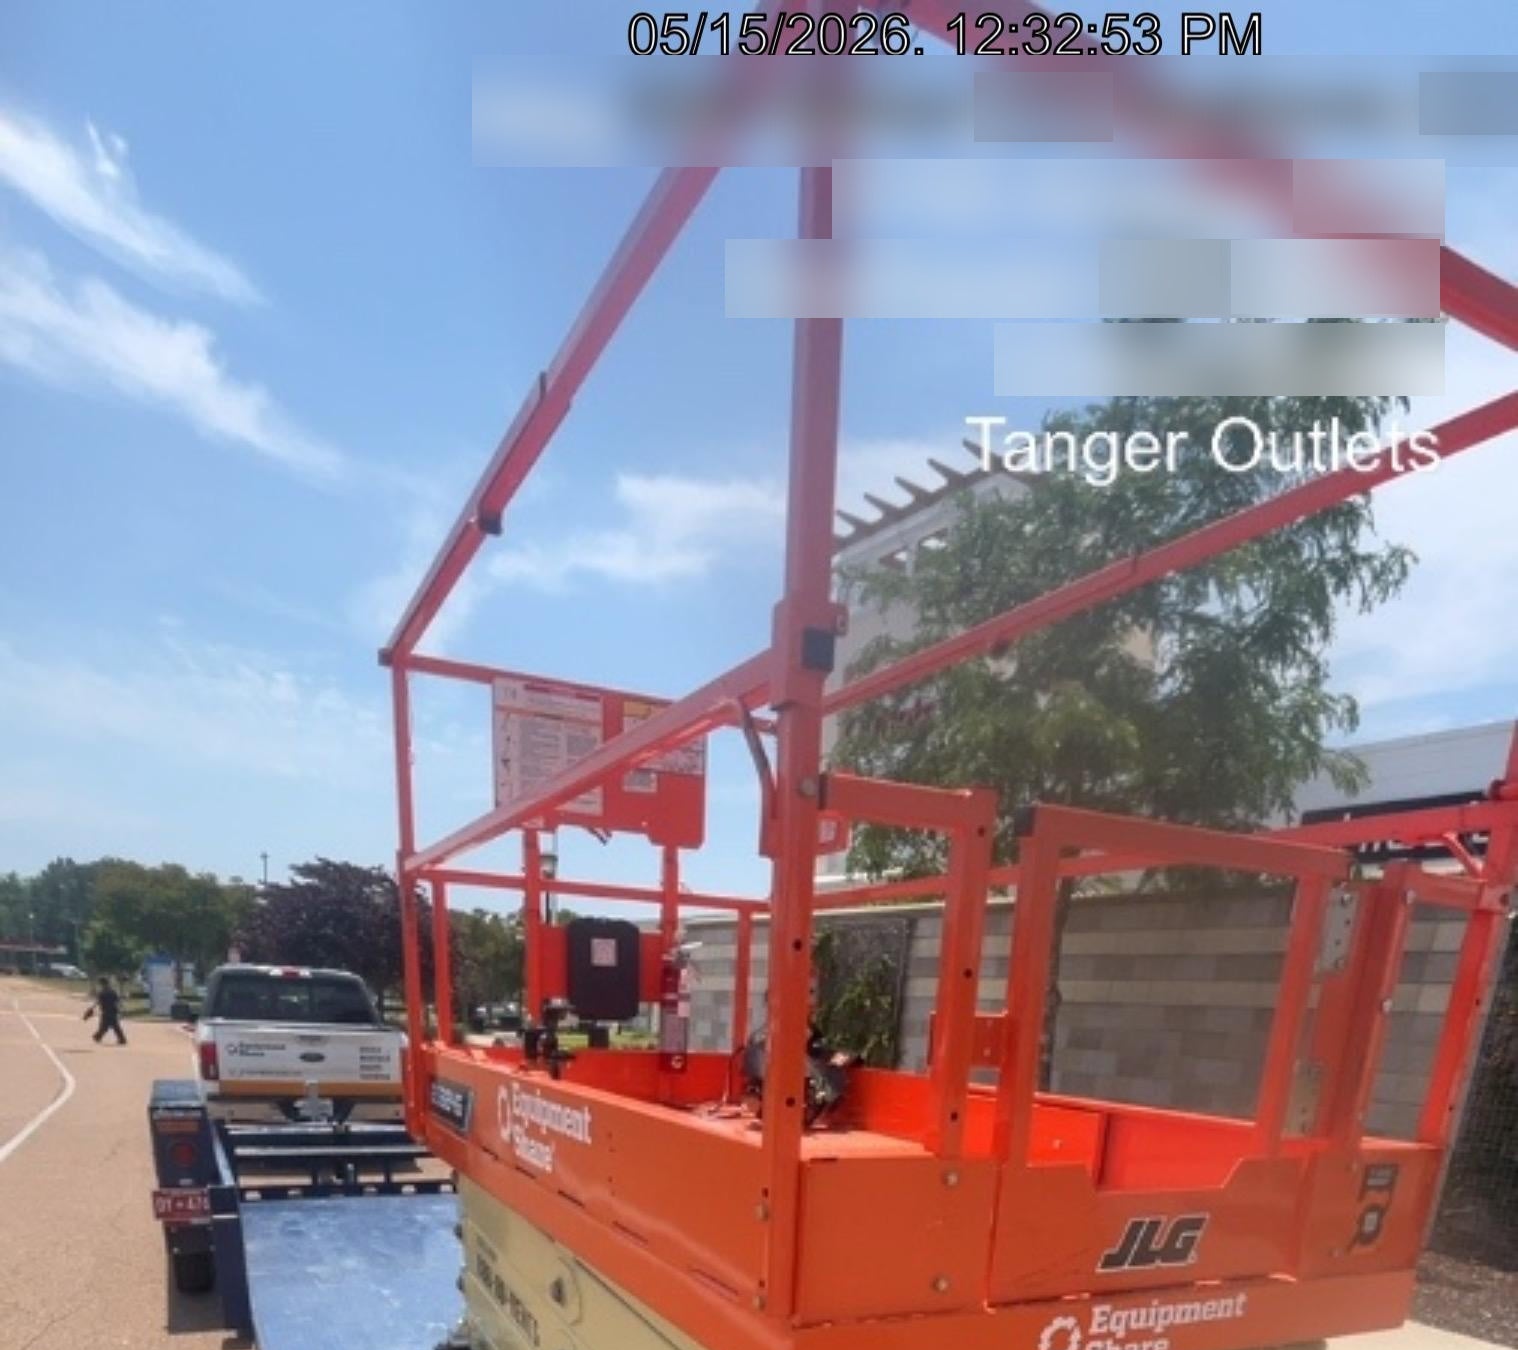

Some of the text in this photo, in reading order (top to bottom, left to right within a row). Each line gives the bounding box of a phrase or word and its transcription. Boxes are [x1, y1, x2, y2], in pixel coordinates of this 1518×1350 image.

[511, 1081, 592, 1145] Equipment
[512, 1124, 553, 1173] Share
[1095, 1211, 1210, 1273] JLG
[1088, 1292, 1248, 1339] Equipment
